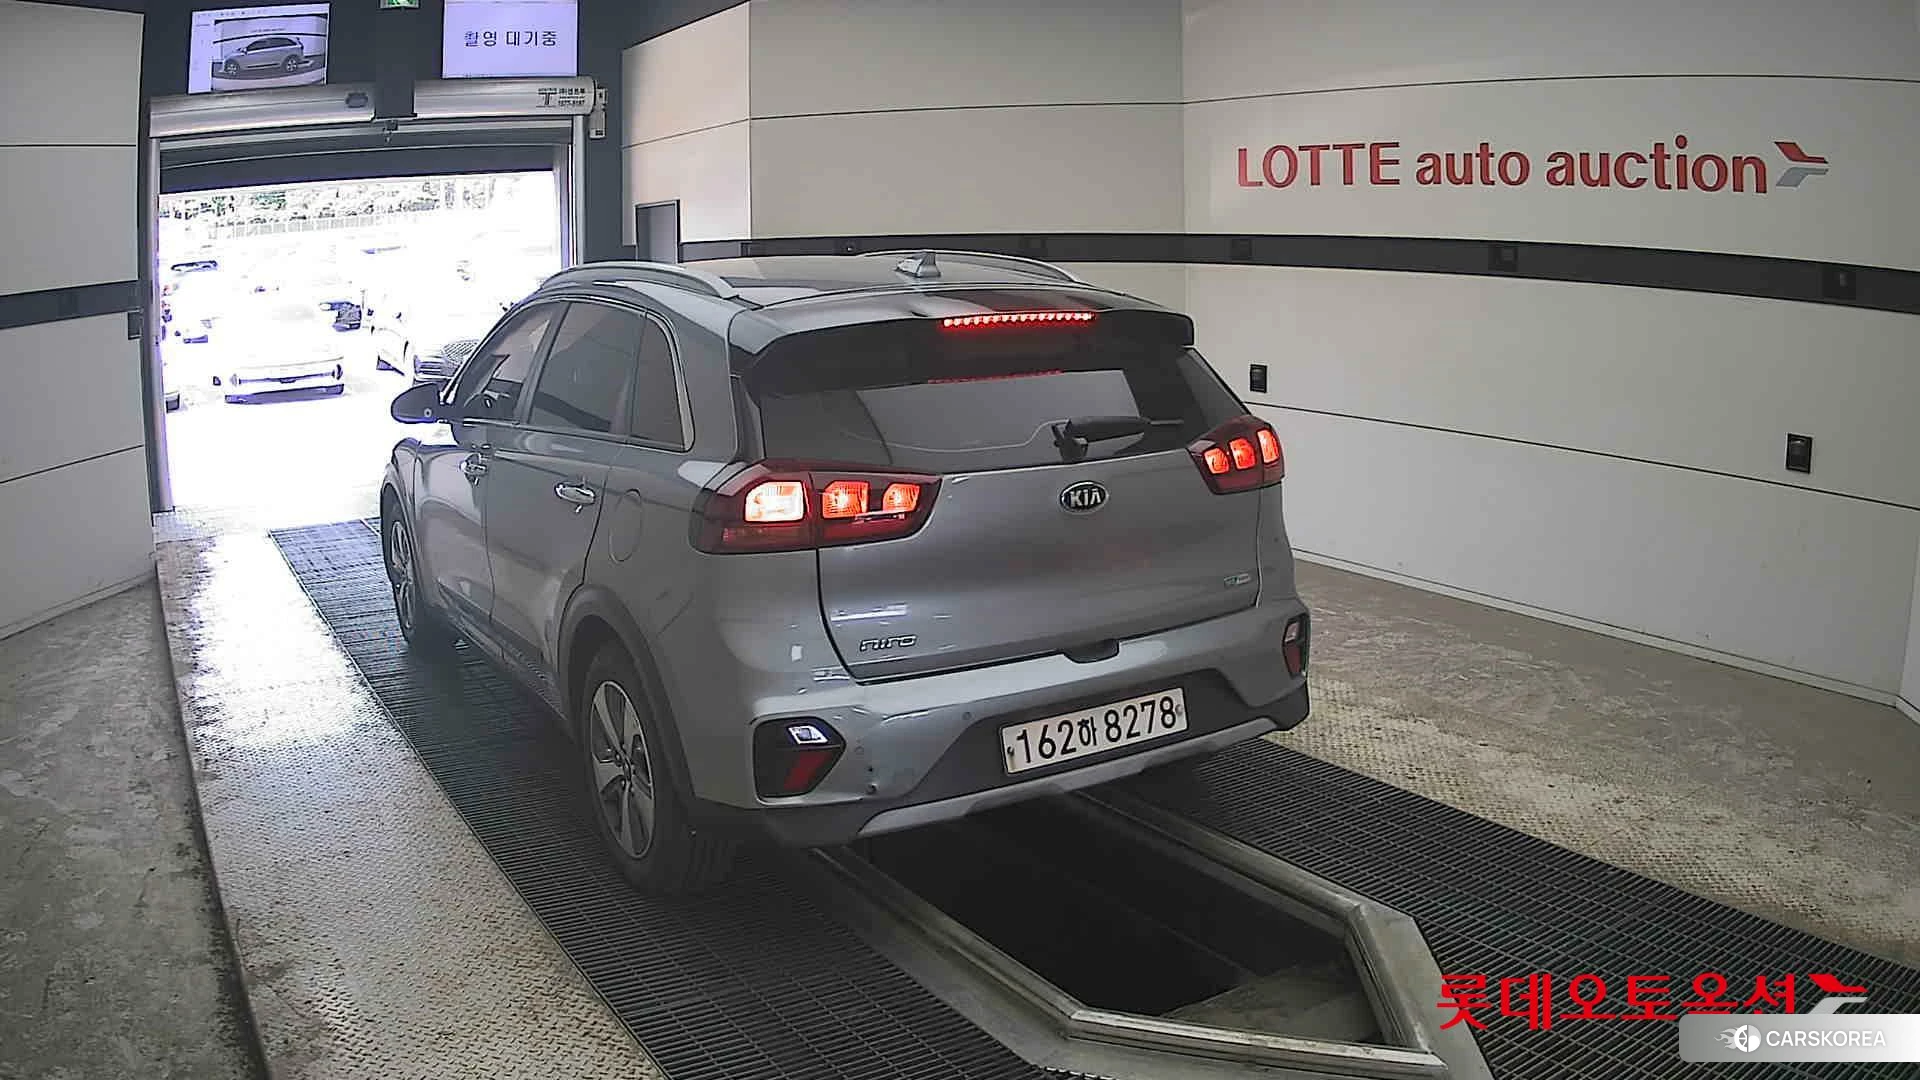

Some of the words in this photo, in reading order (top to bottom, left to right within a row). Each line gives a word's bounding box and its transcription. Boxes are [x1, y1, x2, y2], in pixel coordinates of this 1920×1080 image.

[465, 31, 497, 47] 촬영
[506, 31, 557, 47] 대기중
[1238, 142, 1400, 188] LOTTE
[1415, 142, 1530, 186] auto
[1546, 134, 1768, 194] auction
[1071, 488, 1102, 508] KIA
[1104, 696, 1177, 743] 8278
